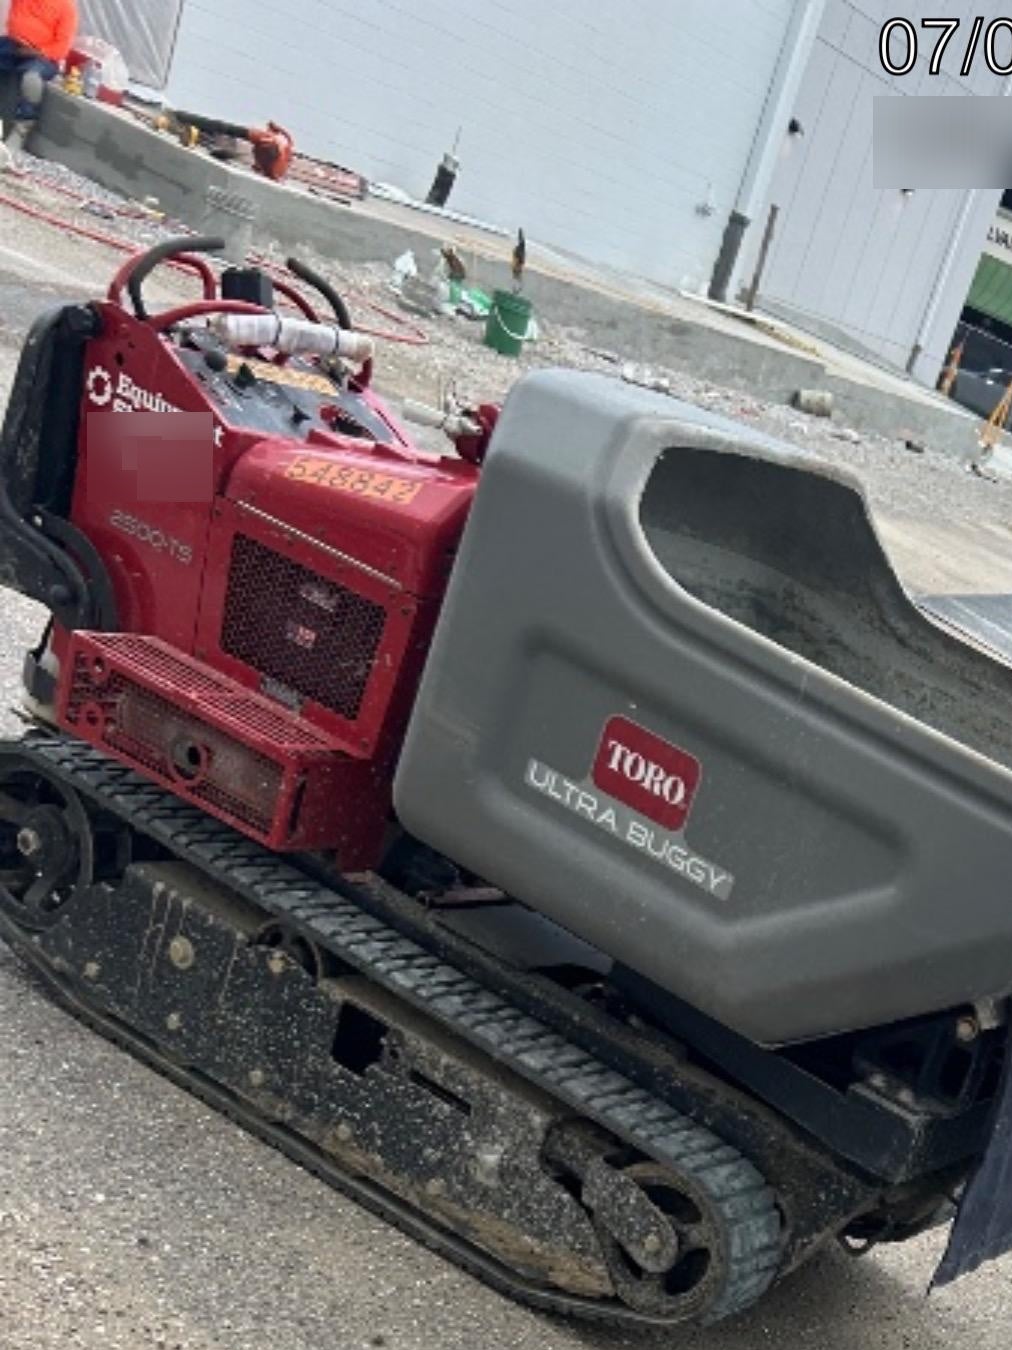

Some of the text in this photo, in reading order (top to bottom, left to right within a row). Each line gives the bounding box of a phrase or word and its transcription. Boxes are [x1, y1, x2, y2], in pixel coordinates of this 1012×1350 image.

[607, 740, 685, 806] TORO
[529, 758, 729, 890] ULTRA BUGGY
